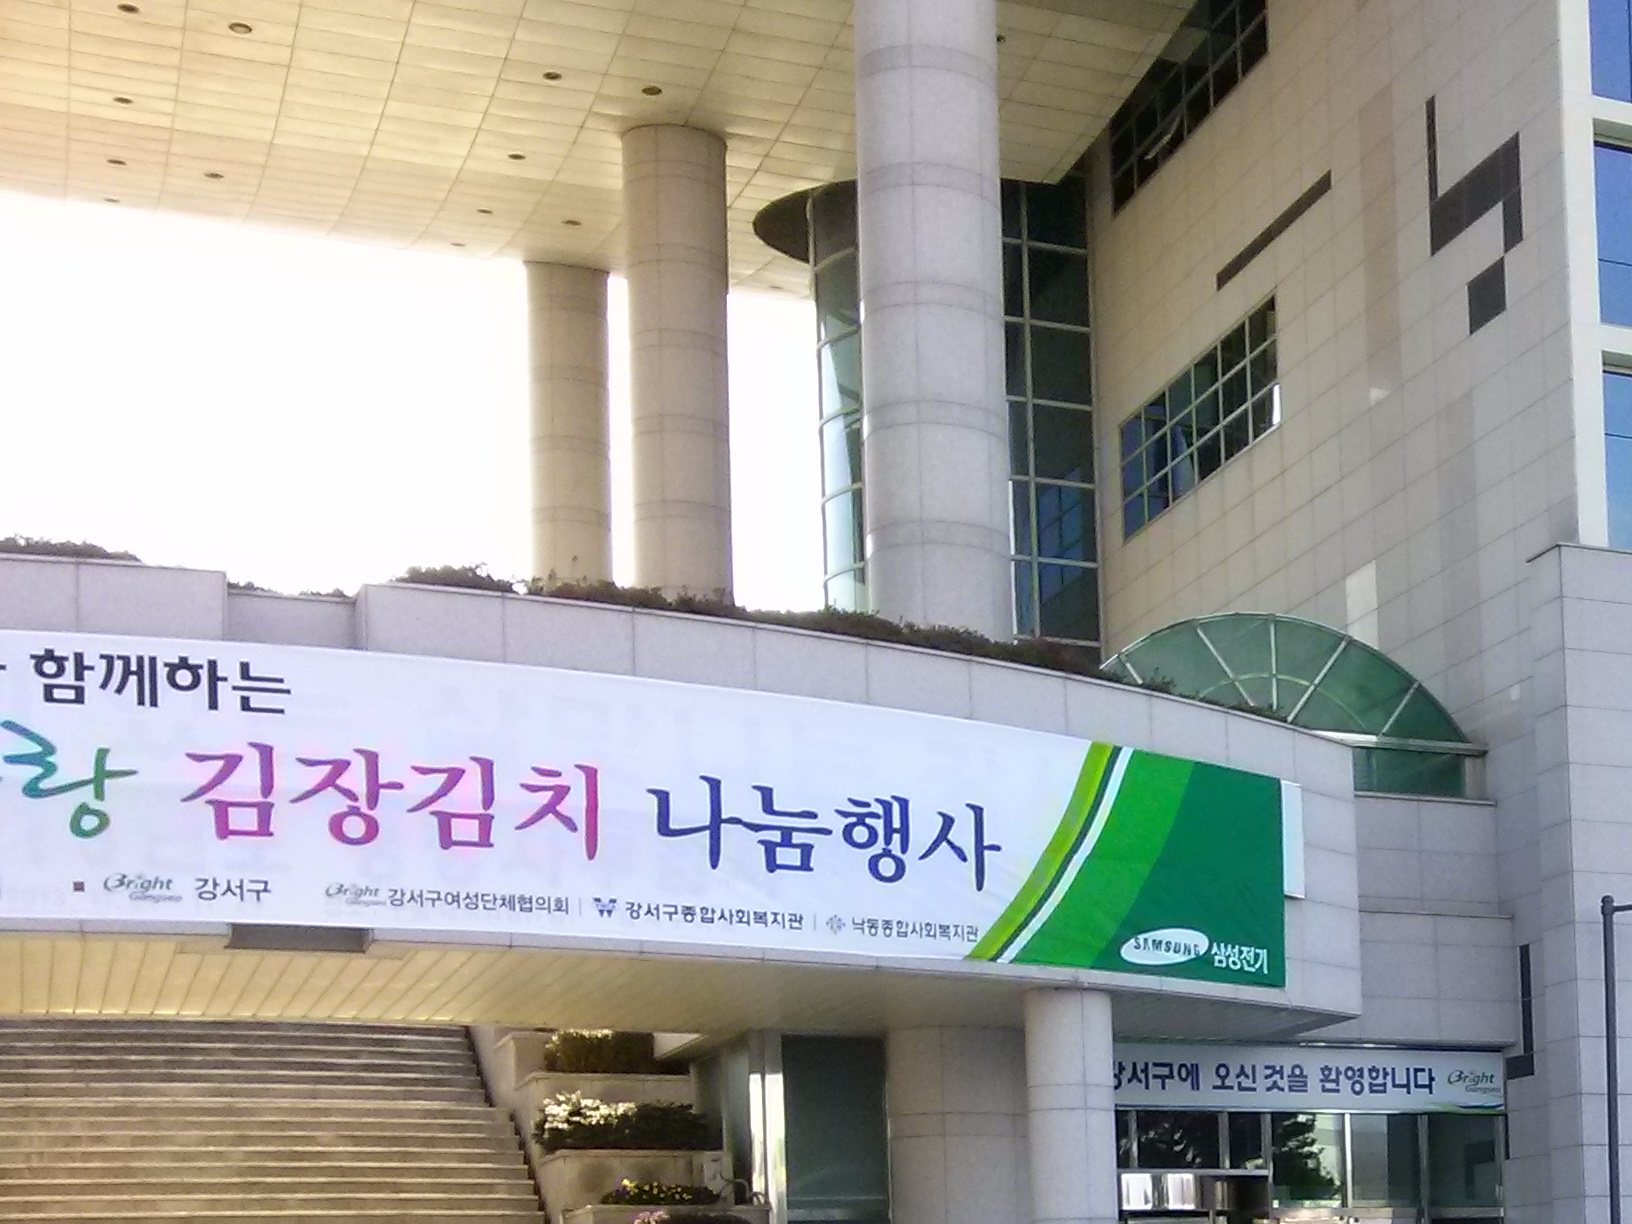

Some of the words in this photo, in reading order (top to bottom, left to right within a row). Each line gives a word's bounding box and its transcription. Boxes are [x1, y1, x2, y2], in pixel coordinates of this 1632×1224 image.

[30, 648, 291, 715] 함께하는
[181, 741, 601, 861] 김장김치
[646, 774, 1002, 892] 나눔행사
[103, 872, 173, 893] Bright
[194, 876, 272, 902] 강서구
[624, 900, 804, 931] 강서구종합사회복지관
[1211, 941, 1269, 975] 삼성전기
[1319, 1064, 1437, 1097] 환영합니다
[1447, 1069, 1496, 1086] Bright
